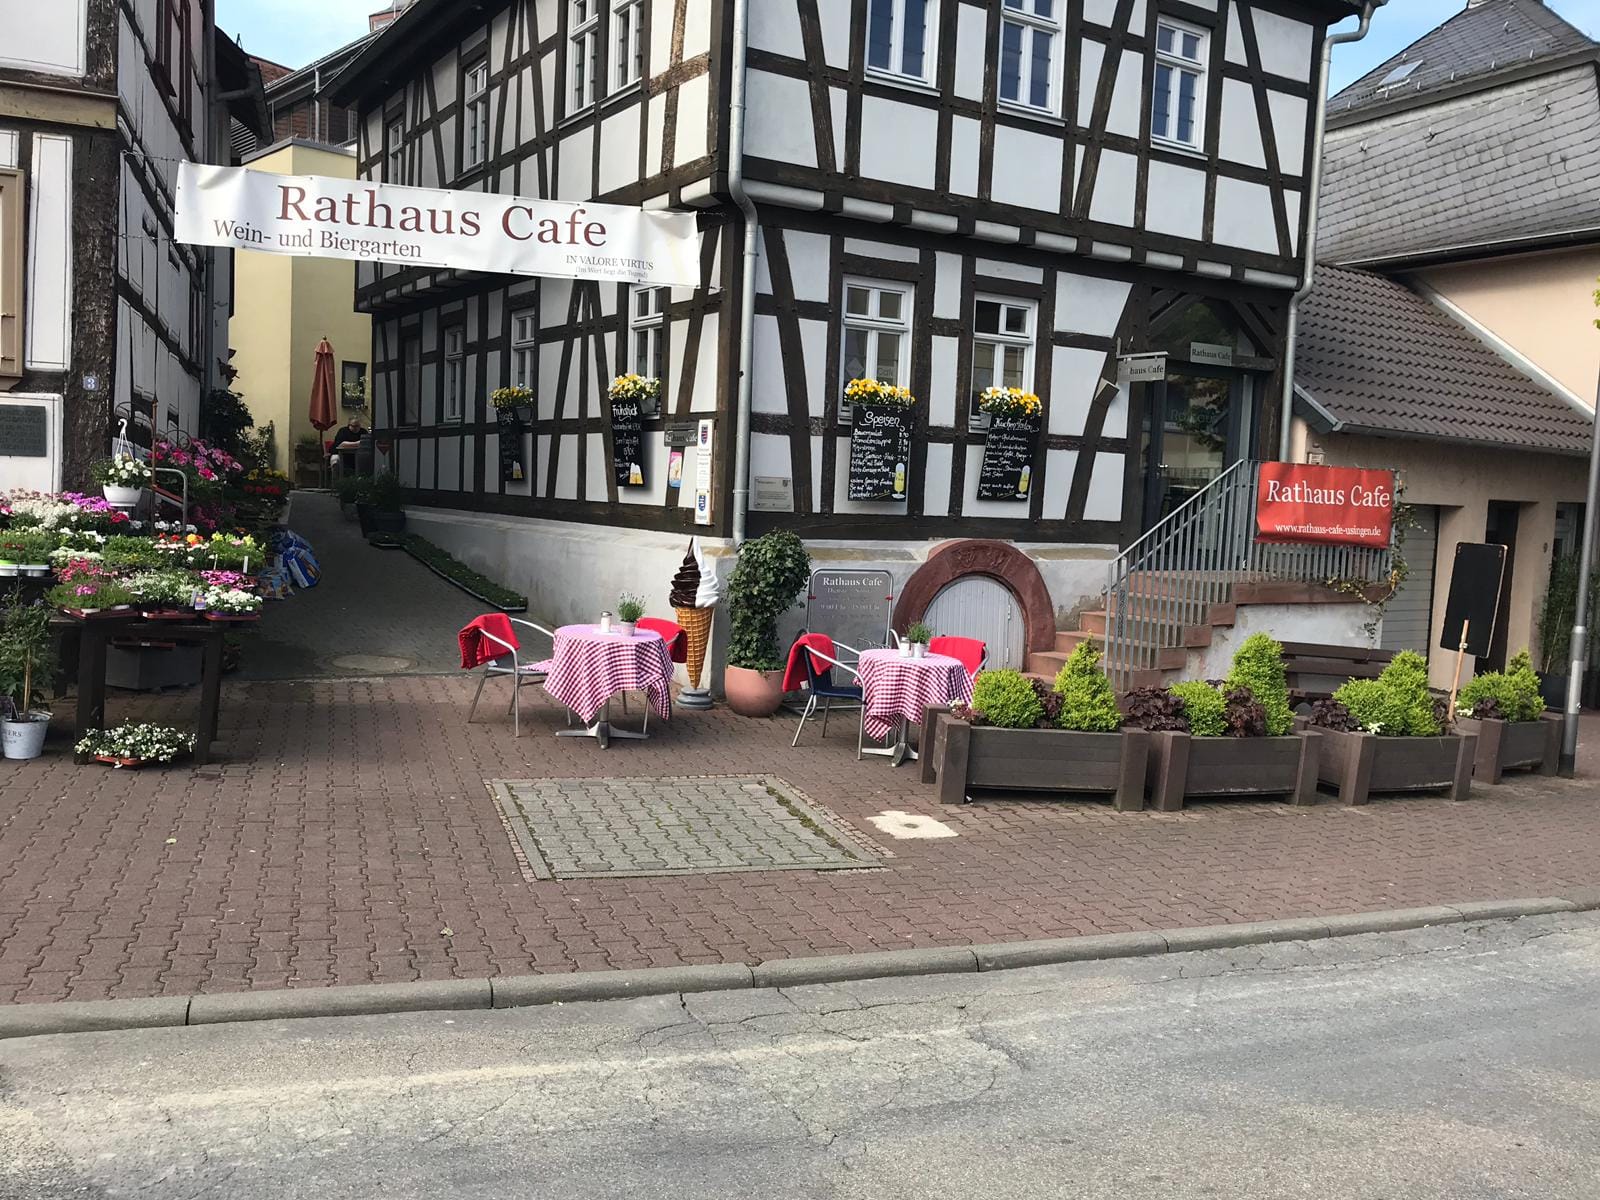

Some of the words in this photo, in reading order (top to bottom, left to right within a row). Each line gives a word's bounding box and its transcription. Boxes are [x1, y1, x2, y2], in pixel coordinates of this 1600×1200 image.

[276, 184, 481, 237] Rathaus
[501, 205, 607, 247] Cafe
[213, 219, 272, 243] Wein-
[278, 228, 313, 248] und
[319, 230, 422, 258] Biergarten
[566, 255, 577, 264] IN
[580, 255, 618, 266] VALORE
[620, 257, 654, 271] VIRTUS
[1191, 348, 1217, 359] Rathaus
[1217, 351, 1231, 361] Cafe
[1147, 364, 1164, 374] Cafe
[87, 378, 96, 389] 3
[863, 411, 903, 429] Speisen
[1266, 480, 1345, 506] Rathaus
[1350, 485, 1390, 508] Cafe
[1275, 523, 1381, 537] www.rathaus-cafe-usingen.de
[823, 576, 861, 587] Rathaus
[862, 577, 883, 587] Cafe
